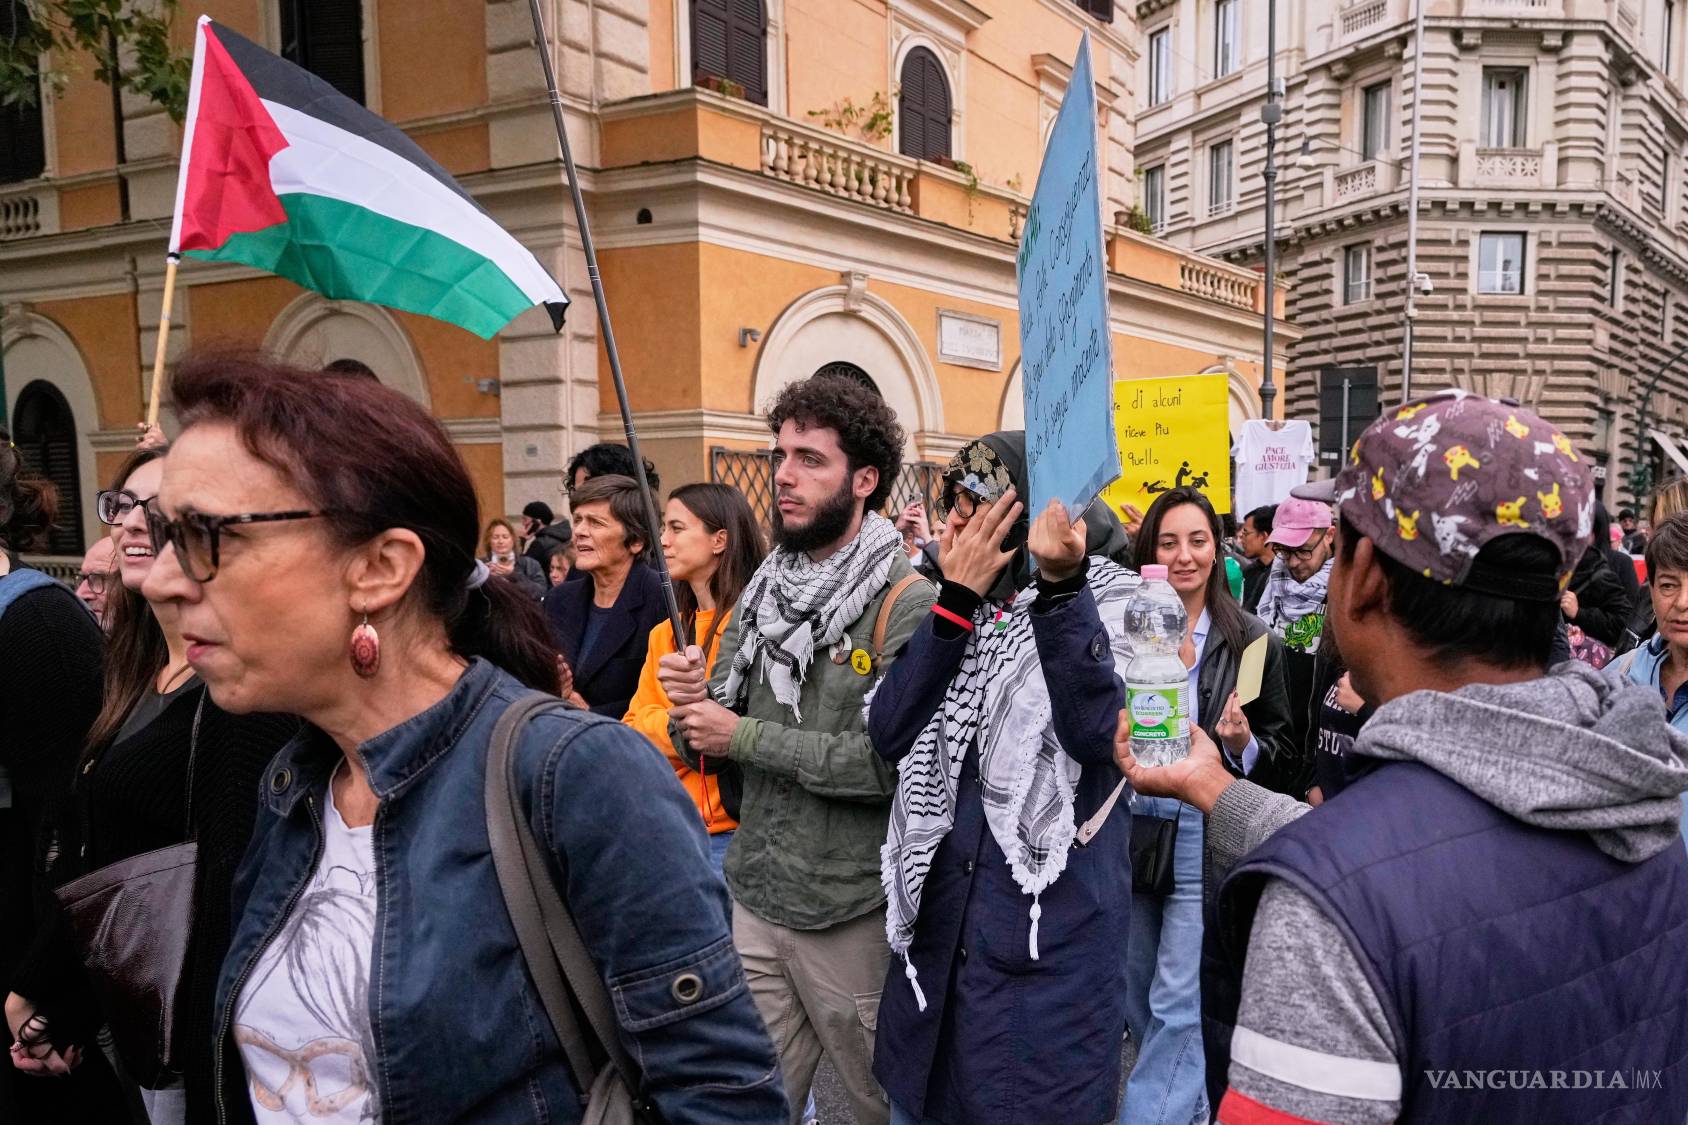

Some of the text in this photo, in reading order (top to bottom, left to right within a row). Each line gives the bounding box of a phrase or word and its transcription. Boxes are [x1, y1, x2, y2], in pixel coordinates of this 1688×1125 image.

[1131, 388, 1144, 409] di
[1152, 385, 1182, 408] alcuni
[1265, 446, 1287, 455] PACE
[1261, 455, 1291, 463] AMORE
